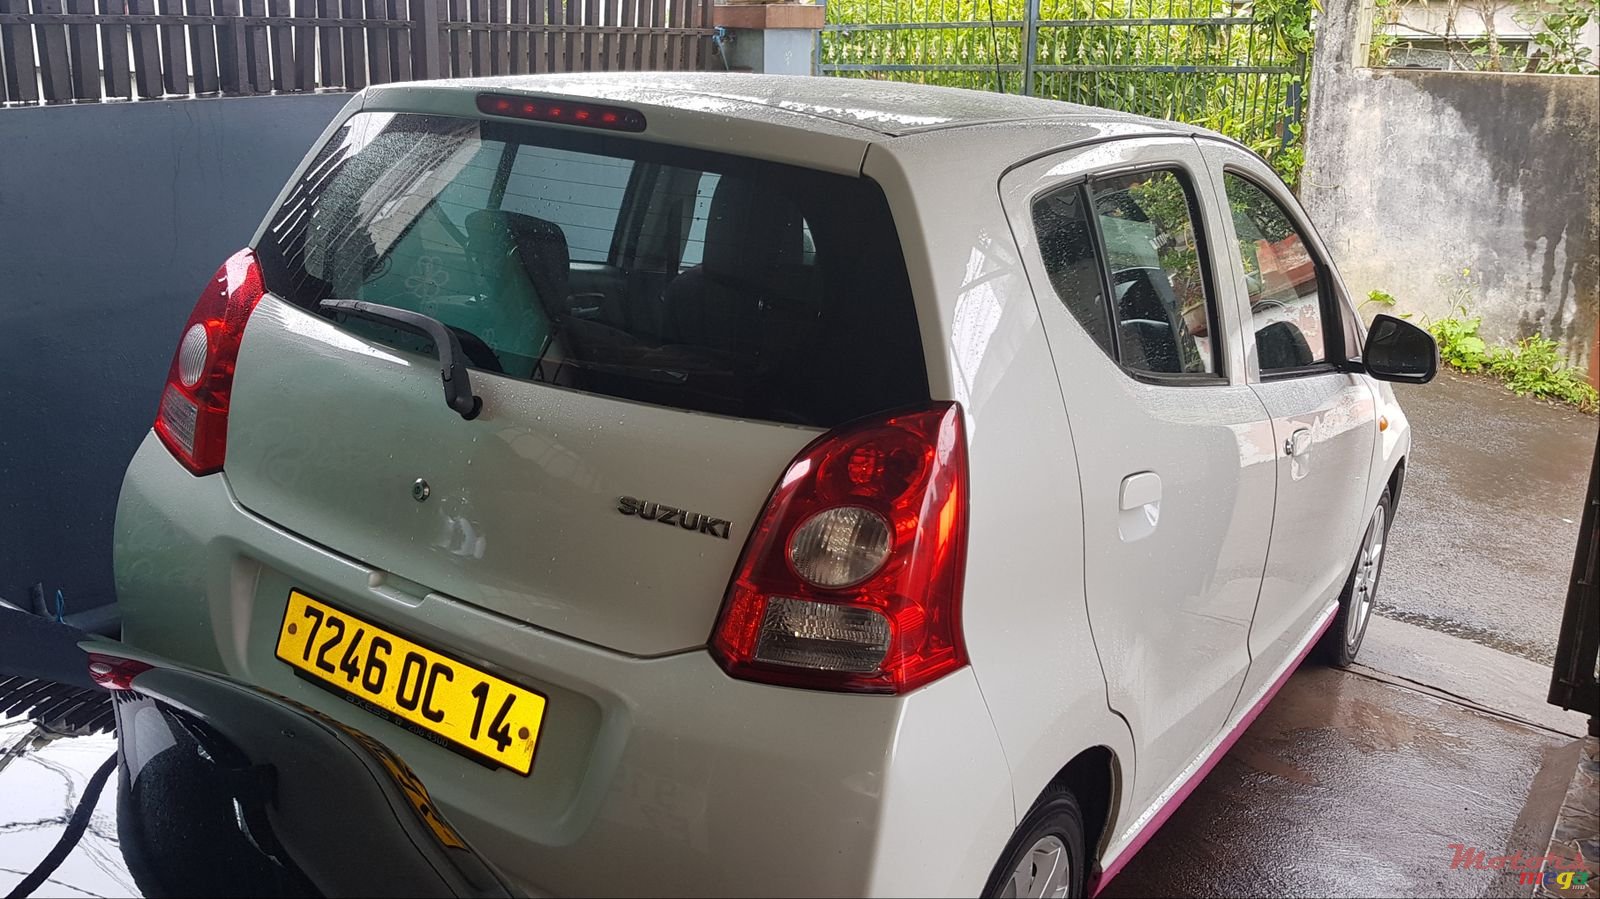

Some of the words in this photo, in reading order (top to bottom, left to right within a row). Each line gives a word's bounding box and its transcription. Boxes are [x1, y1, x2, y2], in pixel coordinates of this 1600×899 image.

[617, 496, 732, 539] SUZUKI
[302, 604, 393, 695] 7246
[395, 651, 454, 724] OC
[469, 681, 517, 752] 14
